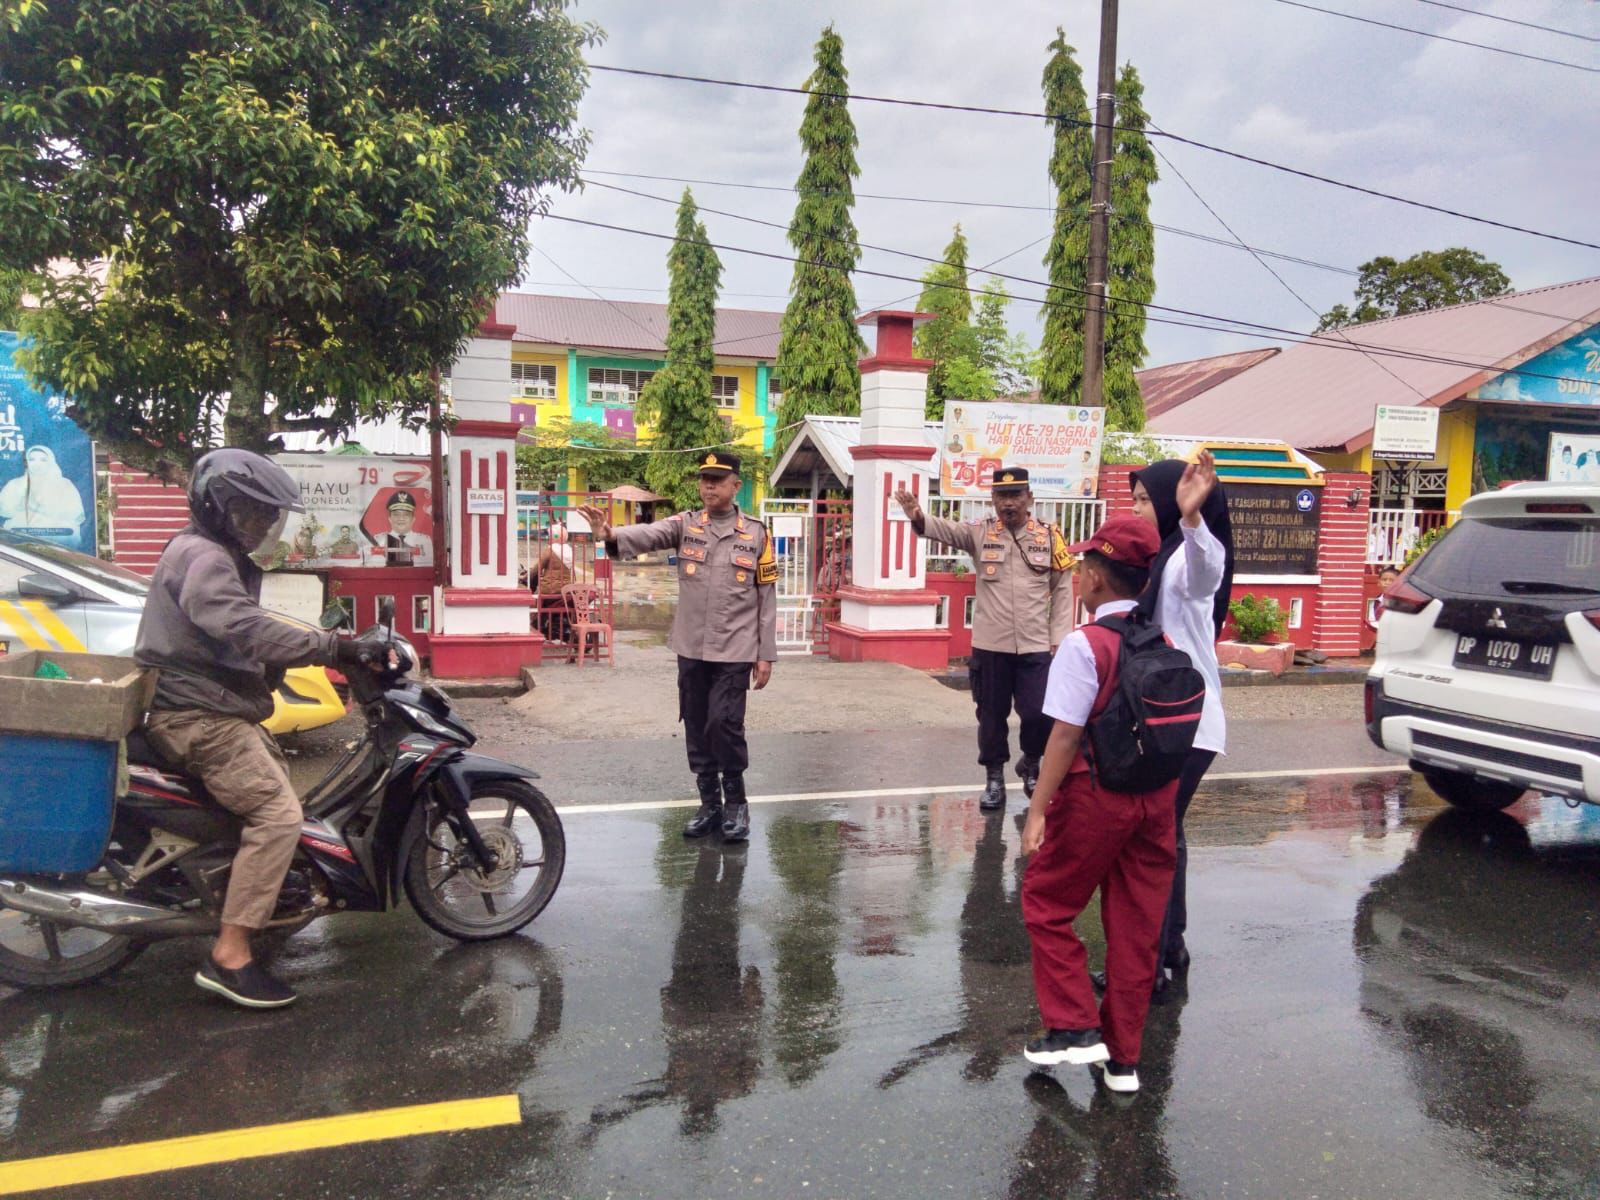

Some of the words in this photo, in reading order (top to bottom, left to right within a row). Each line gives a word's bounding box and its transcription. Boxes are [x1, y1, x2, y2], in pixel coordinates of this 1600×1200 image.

[1557, 377, 1592, 395] SDN
[985, 422, 1015, 436] HUT
[1016, 424, 1054, 437] KE-79
[1056, 426, 1088, 438] PGRI
[1089, 426, 1098, 438] &
[988, 435, 1012, 445] HARI
[1015, 436, 1042, 446] GURU
[1045, 437, 1093, 448] NASIONAL
[1012, 445, 1046, 455] TAHUN
[1048, 447, 1072, 456] 2024
[358, 467, 379, 486] 79
[300, 482, 349, 496] HAYU
[470, 493, 503, 501] BATAS
[733, 544, 757, 554] POLRI
[1028, 545, 1050, 553] POLRI
[1102, 542, 1113, 554] SD
[1458, 636, 1477, 654] DP
[1486, 640, 1520, 660] 1070
[1530, 645, 1553, 665] UH
